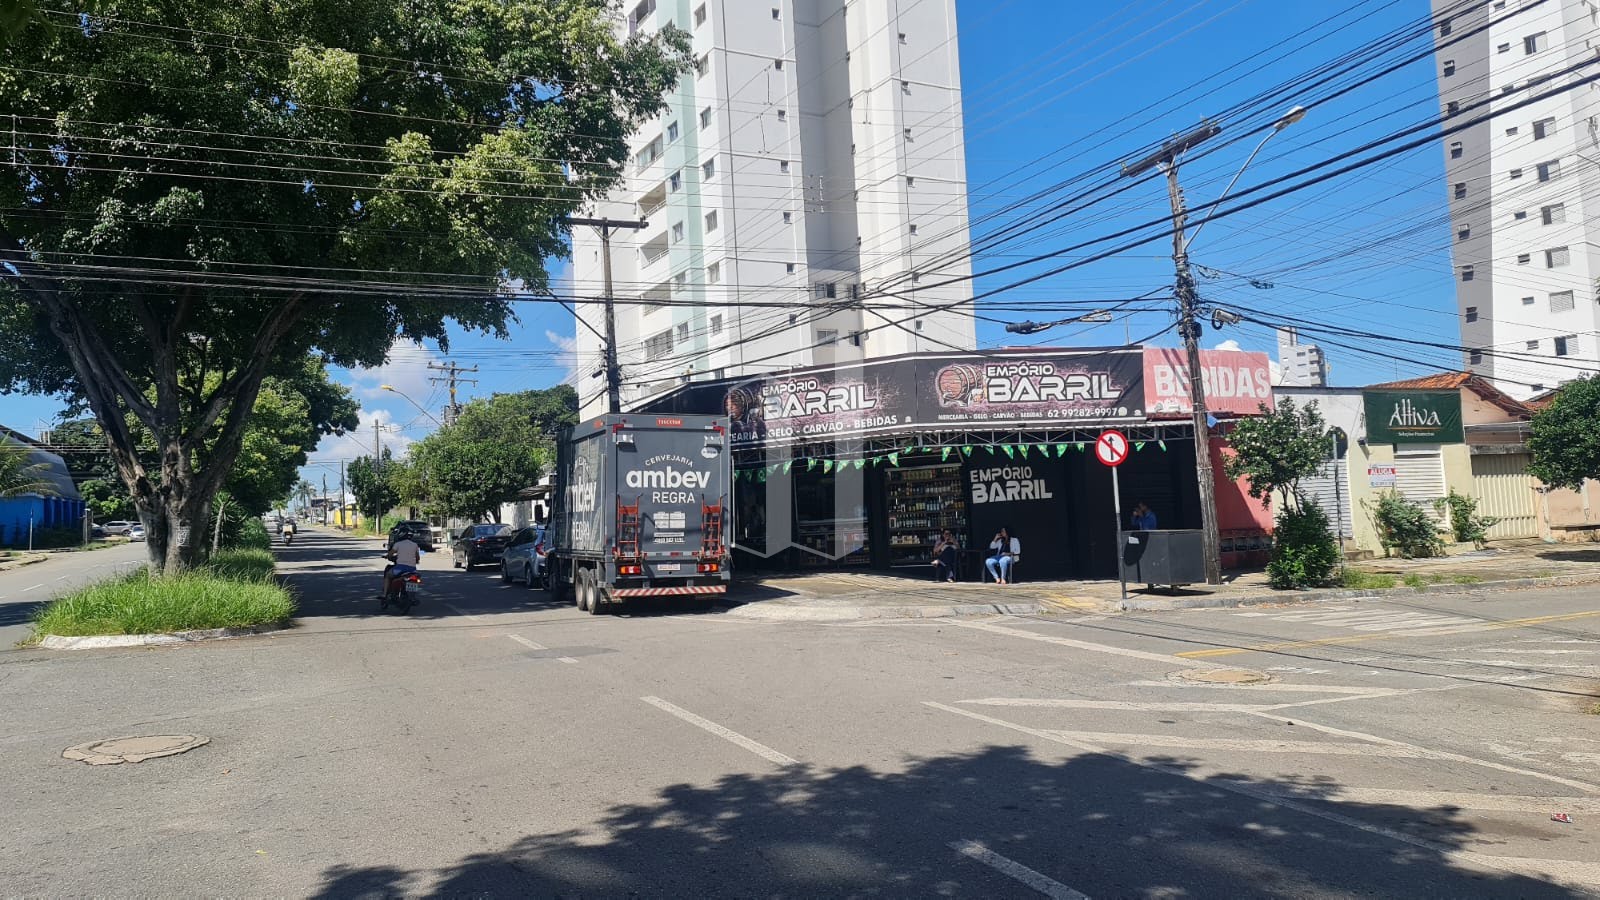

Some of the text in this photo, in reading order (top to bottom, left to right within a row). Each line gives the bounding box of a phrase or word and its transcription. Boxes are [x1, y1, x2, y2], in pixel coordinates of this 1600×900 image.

[987, 362, 1054, 377] EMPÓRIO
[763, 380, 817, 397] EMPÓRIO
[988, 375, 1122, 402] BARRIL
[764, 384, 877, 420] BARRIL
[1047, 408, 1059, 418] 62
[1388, 398, 1441, 427] Attiva
[767, 427, 793, 438] GELO
[854, 414, 898, 429] BEBIDAS
[645, 454, 694, 468] CERVEJARIA
[626, 466, 711, 489] ambev
[969, 465, 1033, 483] EMPÓRIO
[652, 491, 696, 504] REGRA
[972, 479, 1053, 504] BARRIL
